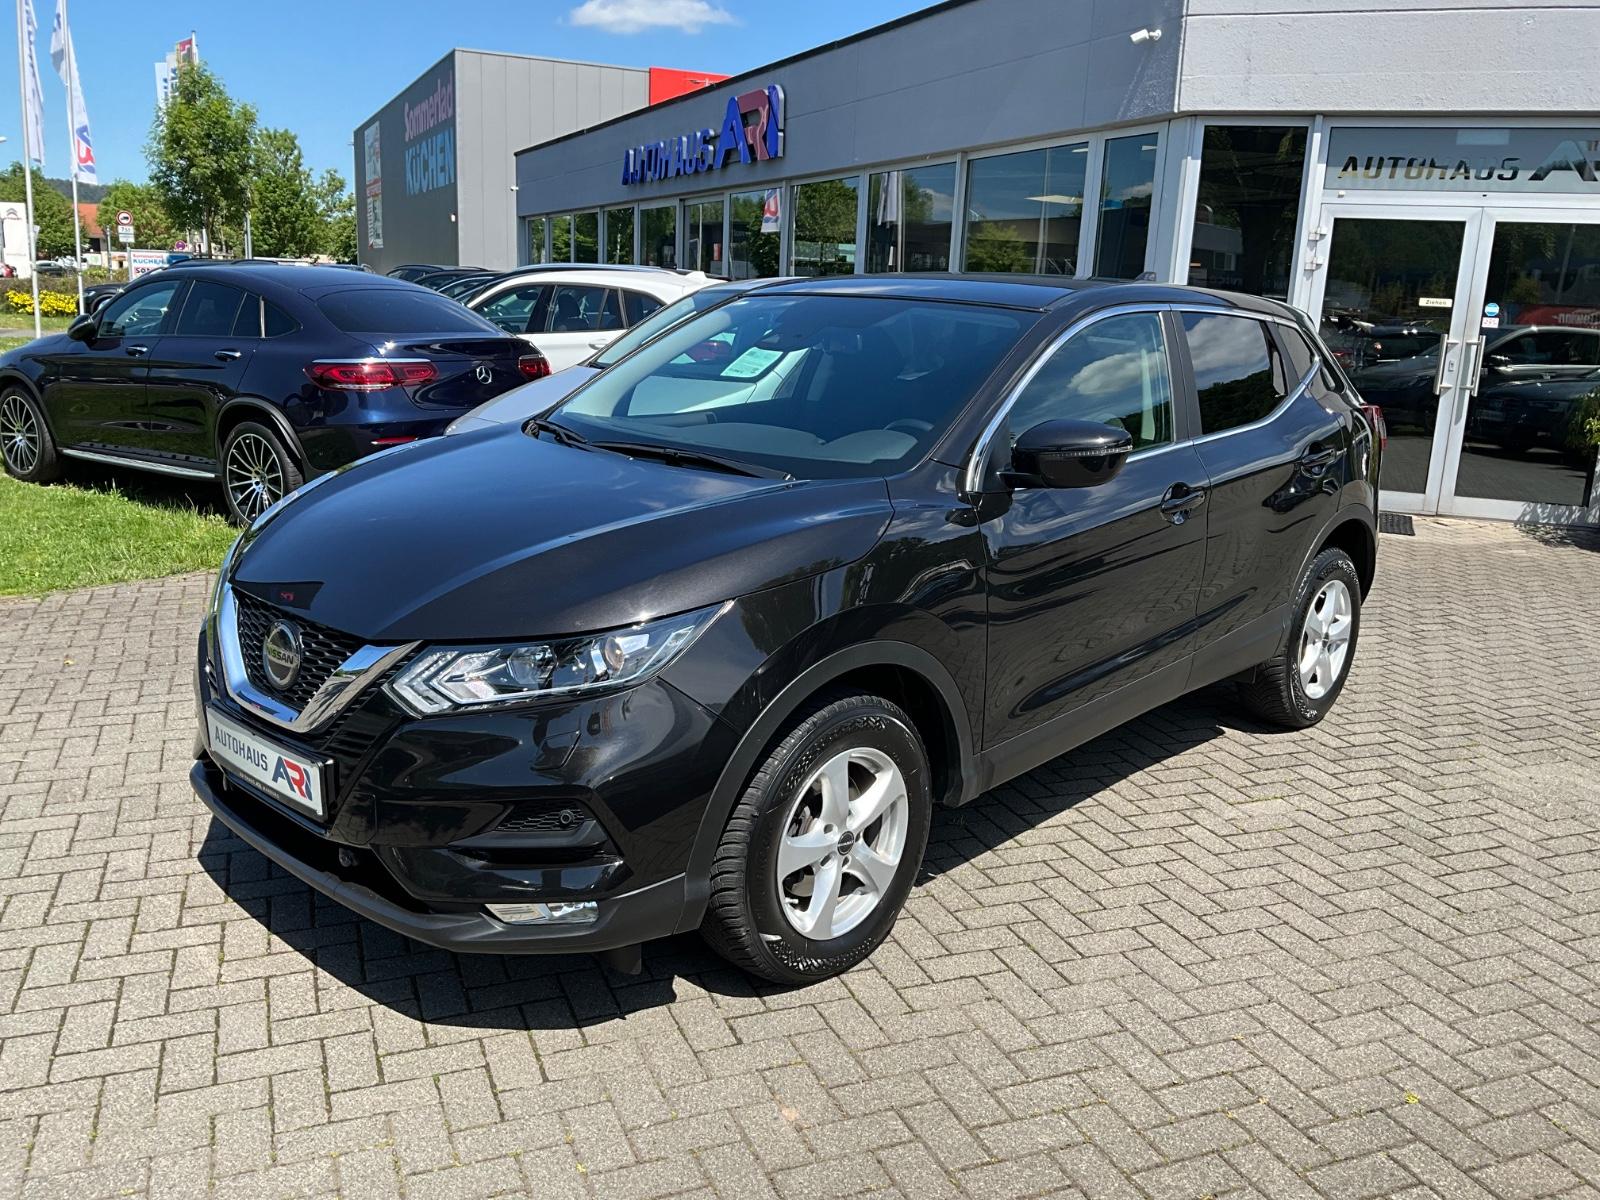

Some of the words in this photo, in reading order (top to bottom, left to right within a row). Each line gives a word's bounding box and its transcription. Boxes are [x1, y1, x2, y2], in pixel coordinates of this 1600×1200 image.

[403, 70, 453, 142] Sommerlad
[621, 128, 715, 186] AUTOHAUS
[714, 84, 785, 169] ARI
[405, 127, 455, 197] KÜCHEN
[1337, 155, 1521, 181] AUTOHAUS
[1528, 139, 1600, 182] A
[214, 725, 268, 772] AUTOHAUS
[271, 755, 313, 802] ARI
